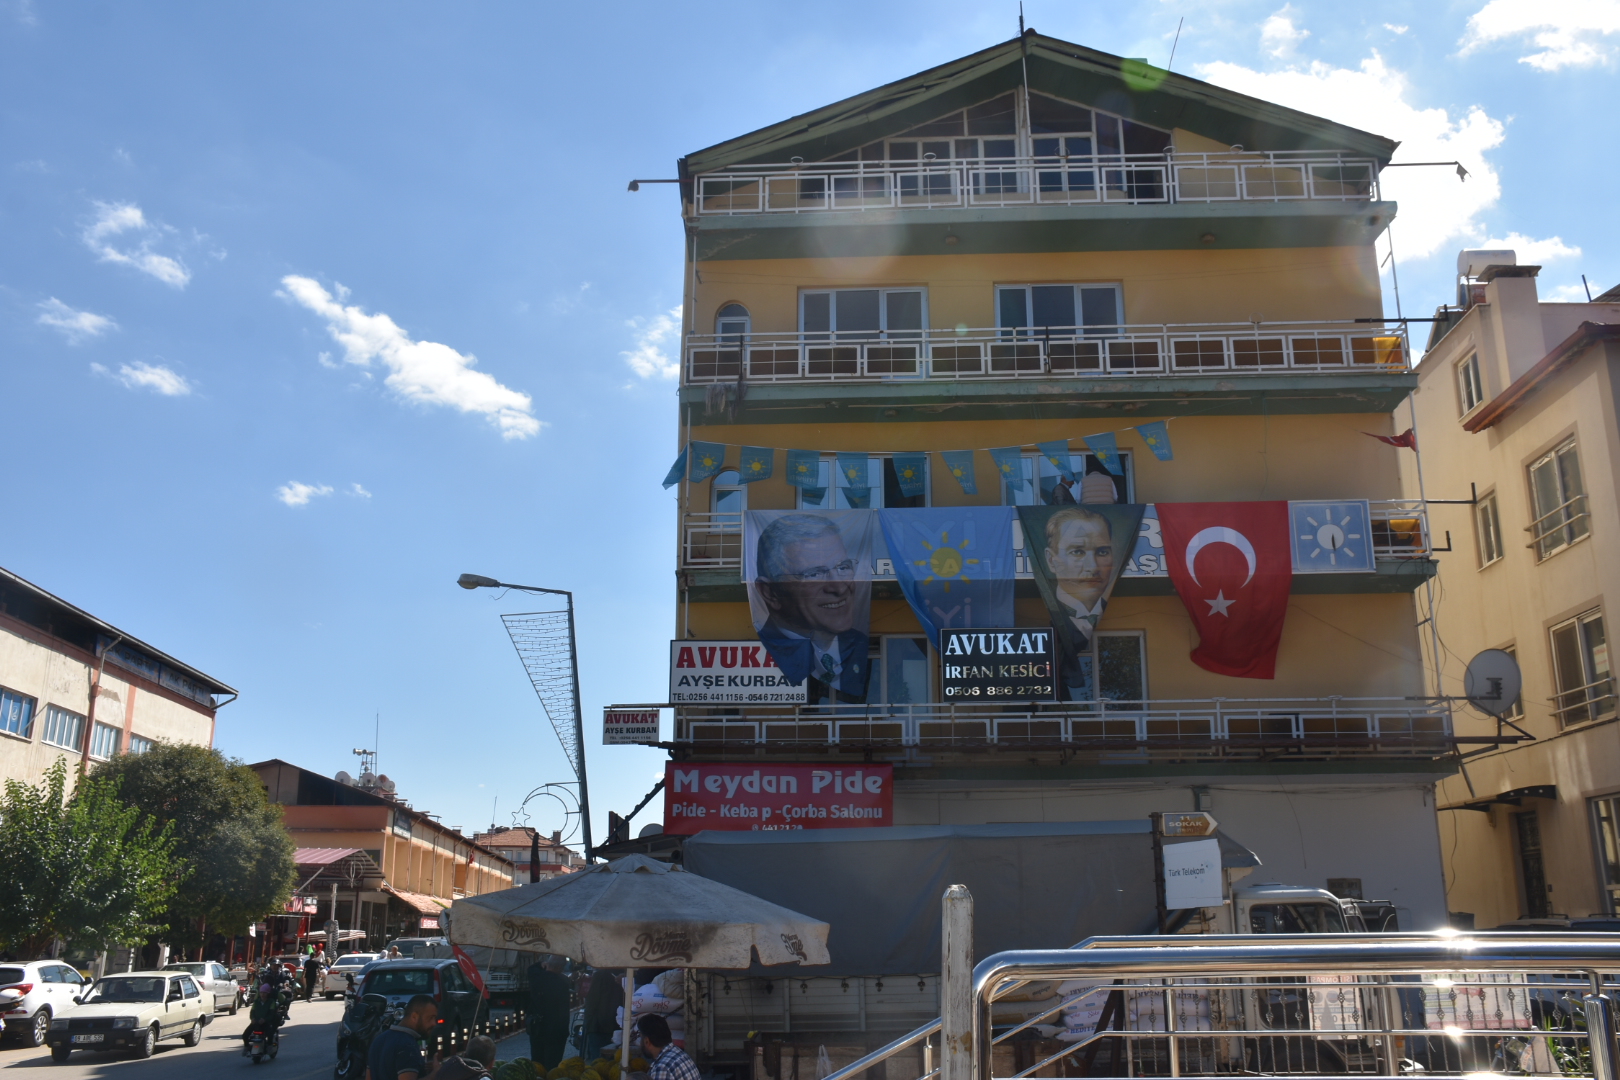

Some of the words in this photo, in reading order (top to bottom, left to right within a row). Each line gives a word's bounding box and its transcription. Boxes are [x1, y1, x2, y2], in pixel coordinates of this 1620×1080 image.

[945, 632, 1048, 656] AVUKAT
[676, 646, 779, 668] AVUKA
[945, 663, 994, 679] İRFAN
[999, 661, 1051, 678] KESİCİ
[677, 675, 725, 690] AYŞE
[727, 674, 803, 688] KURBA
[710, 693, 724, 701] 441
[945, 686, 981, 696] 0506
[1016, 685, 1052, 696] 2732
[605, 713, 658, 724] AVUKAT
[605, 727, 624, 735] AYŞE
[811, 770, 883, 794] Pide
[672, 802, 706, 818] Pide
[830, 804, 883, 819] Salonu
[1168, 868, 1181, 877] Türk
[1182, 867, 1206, 876] Telekom
